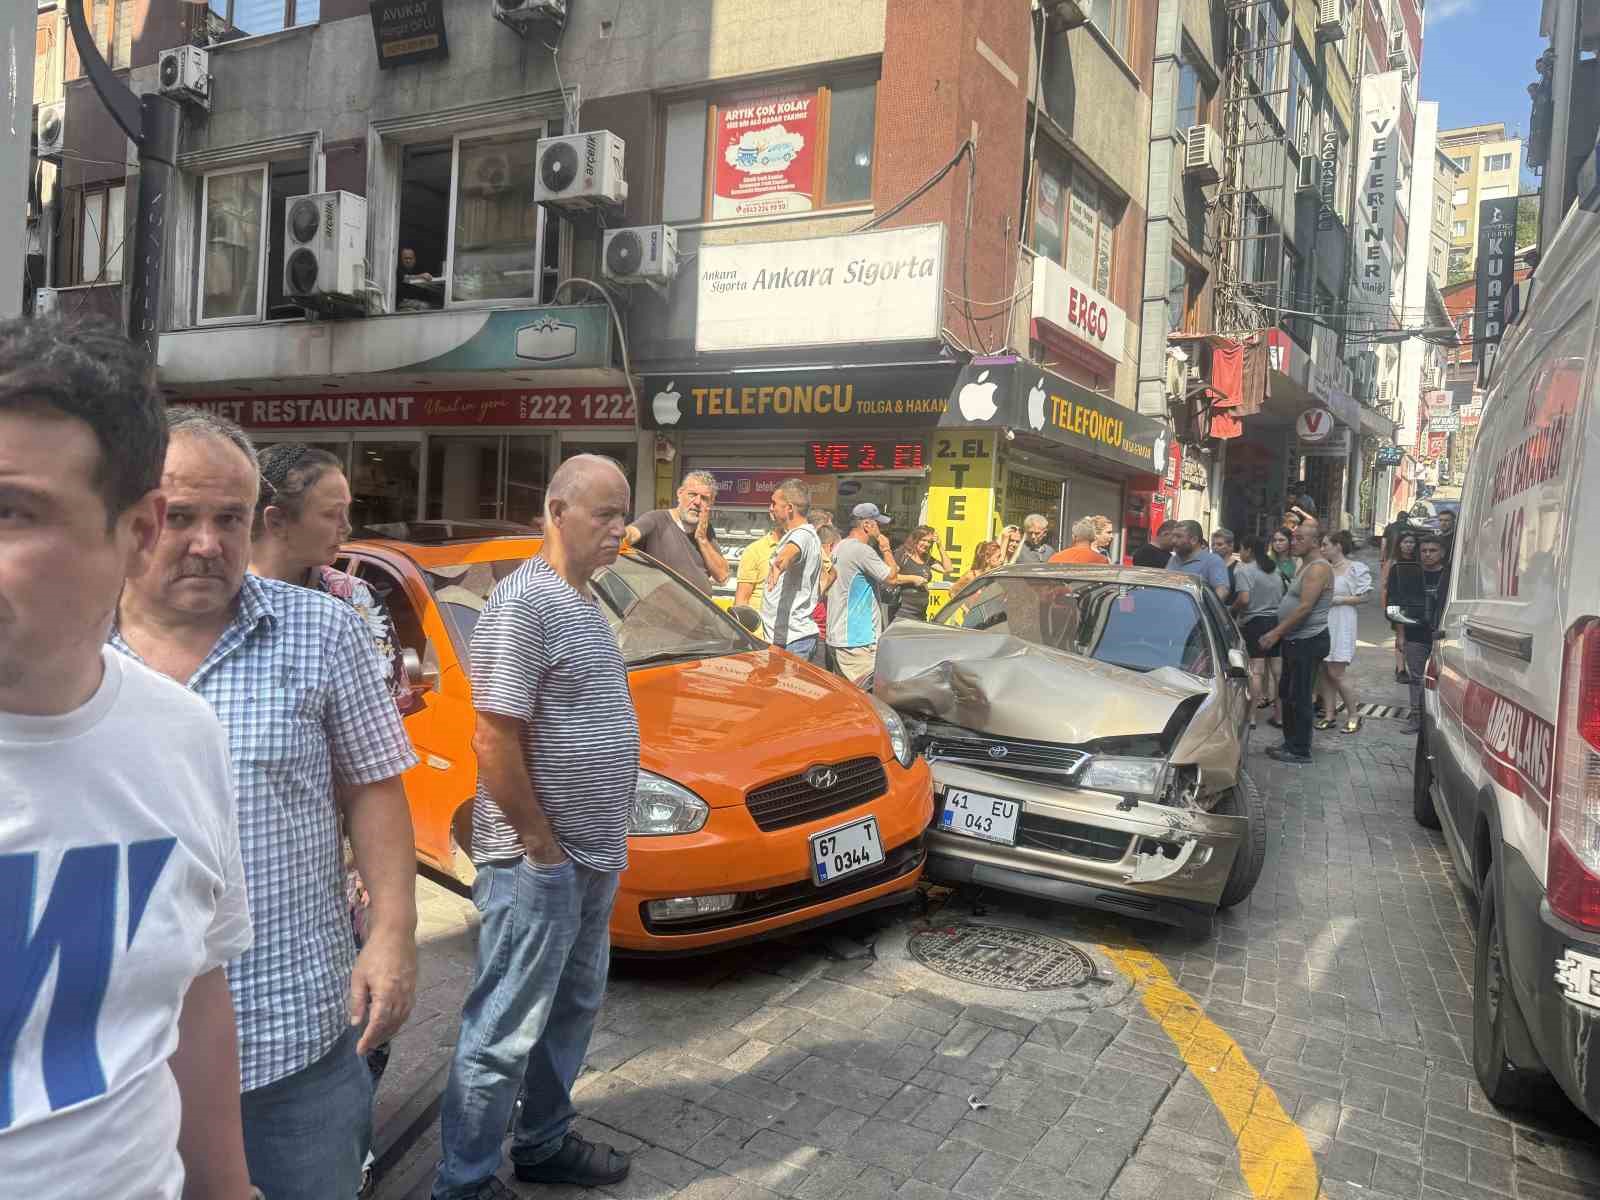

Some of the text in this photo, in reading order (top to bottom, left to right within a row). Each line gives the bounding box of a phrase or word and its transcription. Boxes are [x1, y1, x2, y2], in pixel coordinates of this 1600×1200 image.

[725, 100, 810, 121] ARTIK ÇOK KOLAY
[703, 269, 737, 281] Ankara
[752, 255, 936, 291] Ankara Sigorta
[710, 280, 748, 294] Sigorta
[1068, 286, 1108, 341] ERGO
[253, 396, 415, 423] RESTAURANT
[529, 394, 637, 419] 222 1222
[692, 383, 949, 416] TELEFONCU TOLGA & HAKAN
[1051, 395, 1124, 447] TELEFONCU
[812, 444, 849, 470] VE
[857, 444, 884, 470] 2.
[937, 439, 989, 458] 2. EL
[952, 793, 1014, 818] 41 EU
[965, 813, 993, 832] 043
[820, 823, 871, 857] 67 T
[834, 846, 870, 873] 0344
